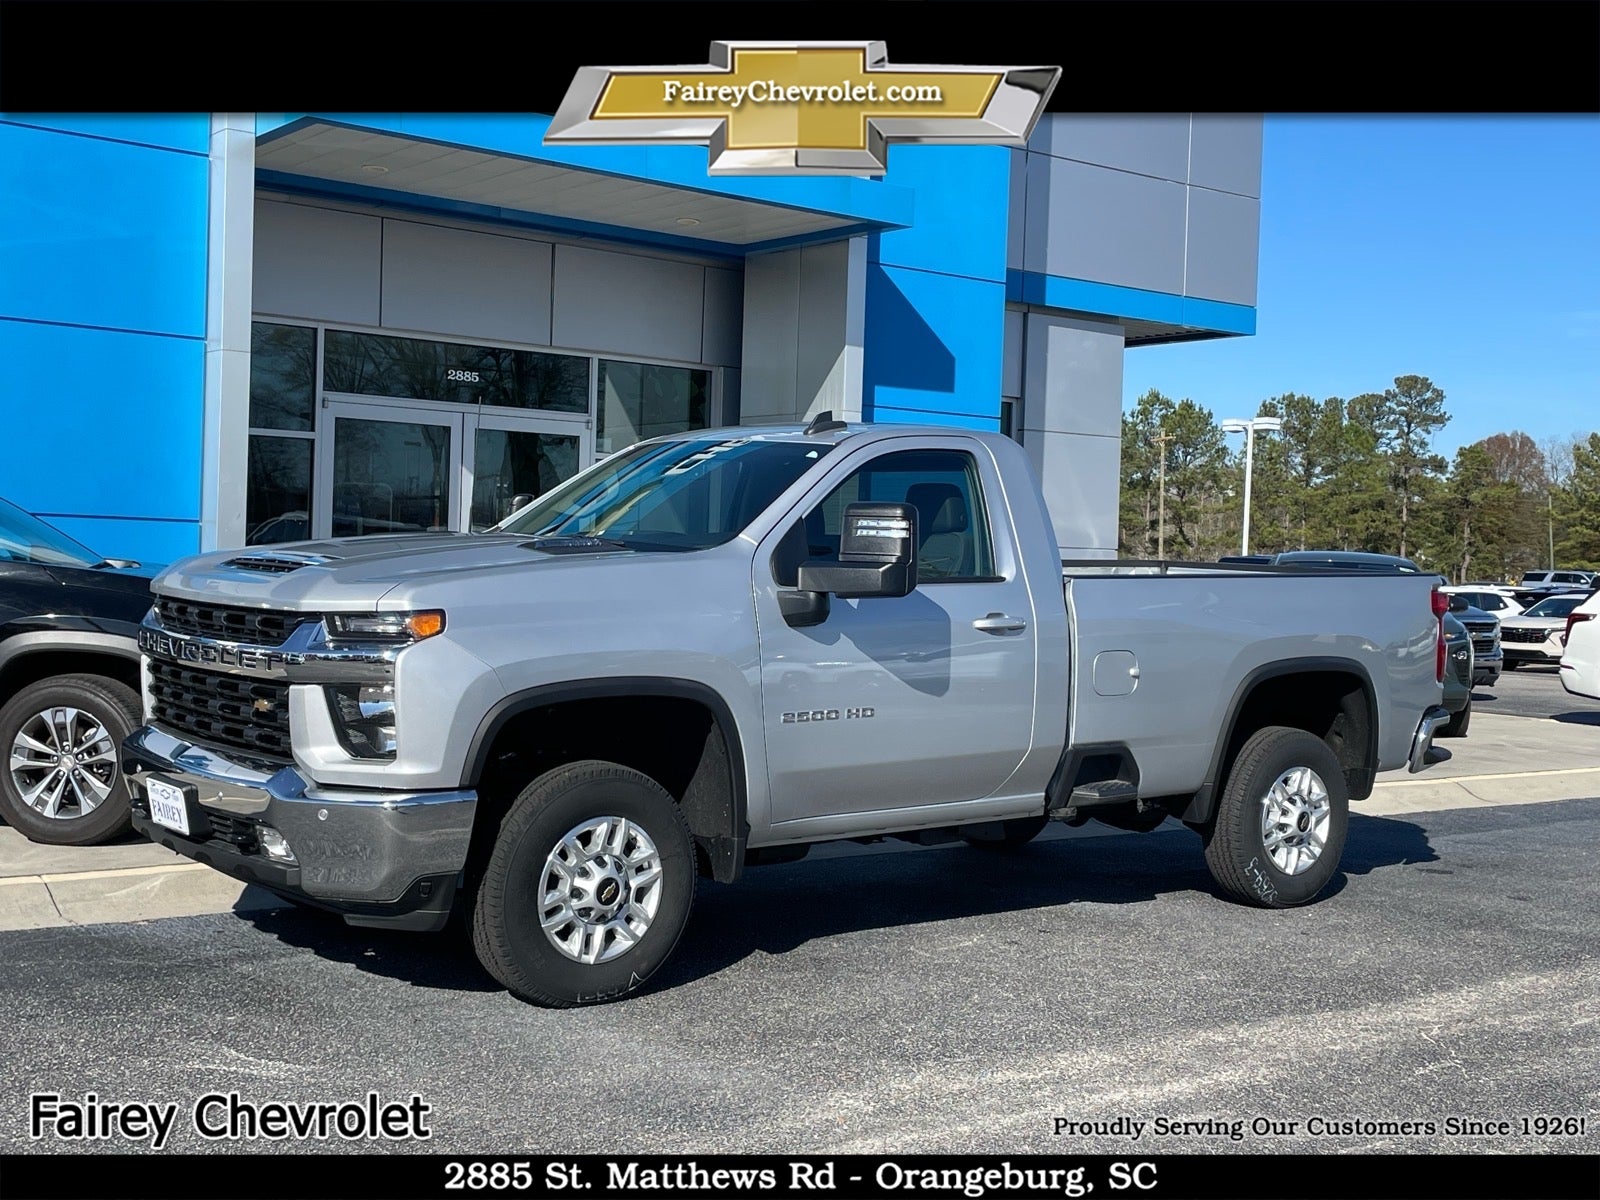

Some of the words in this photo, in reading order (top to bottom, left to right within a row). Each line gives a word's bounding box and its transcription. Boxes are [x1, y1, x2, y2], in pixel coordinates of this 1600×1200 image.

[447, 369, 479, 383] 2885
[138, 630, 280, 672] CHEVROLET
[781, 709, 839, 723] 2500
[845, 707, 875, 719] HD
[151, 798, 182, 824] FAIREY
